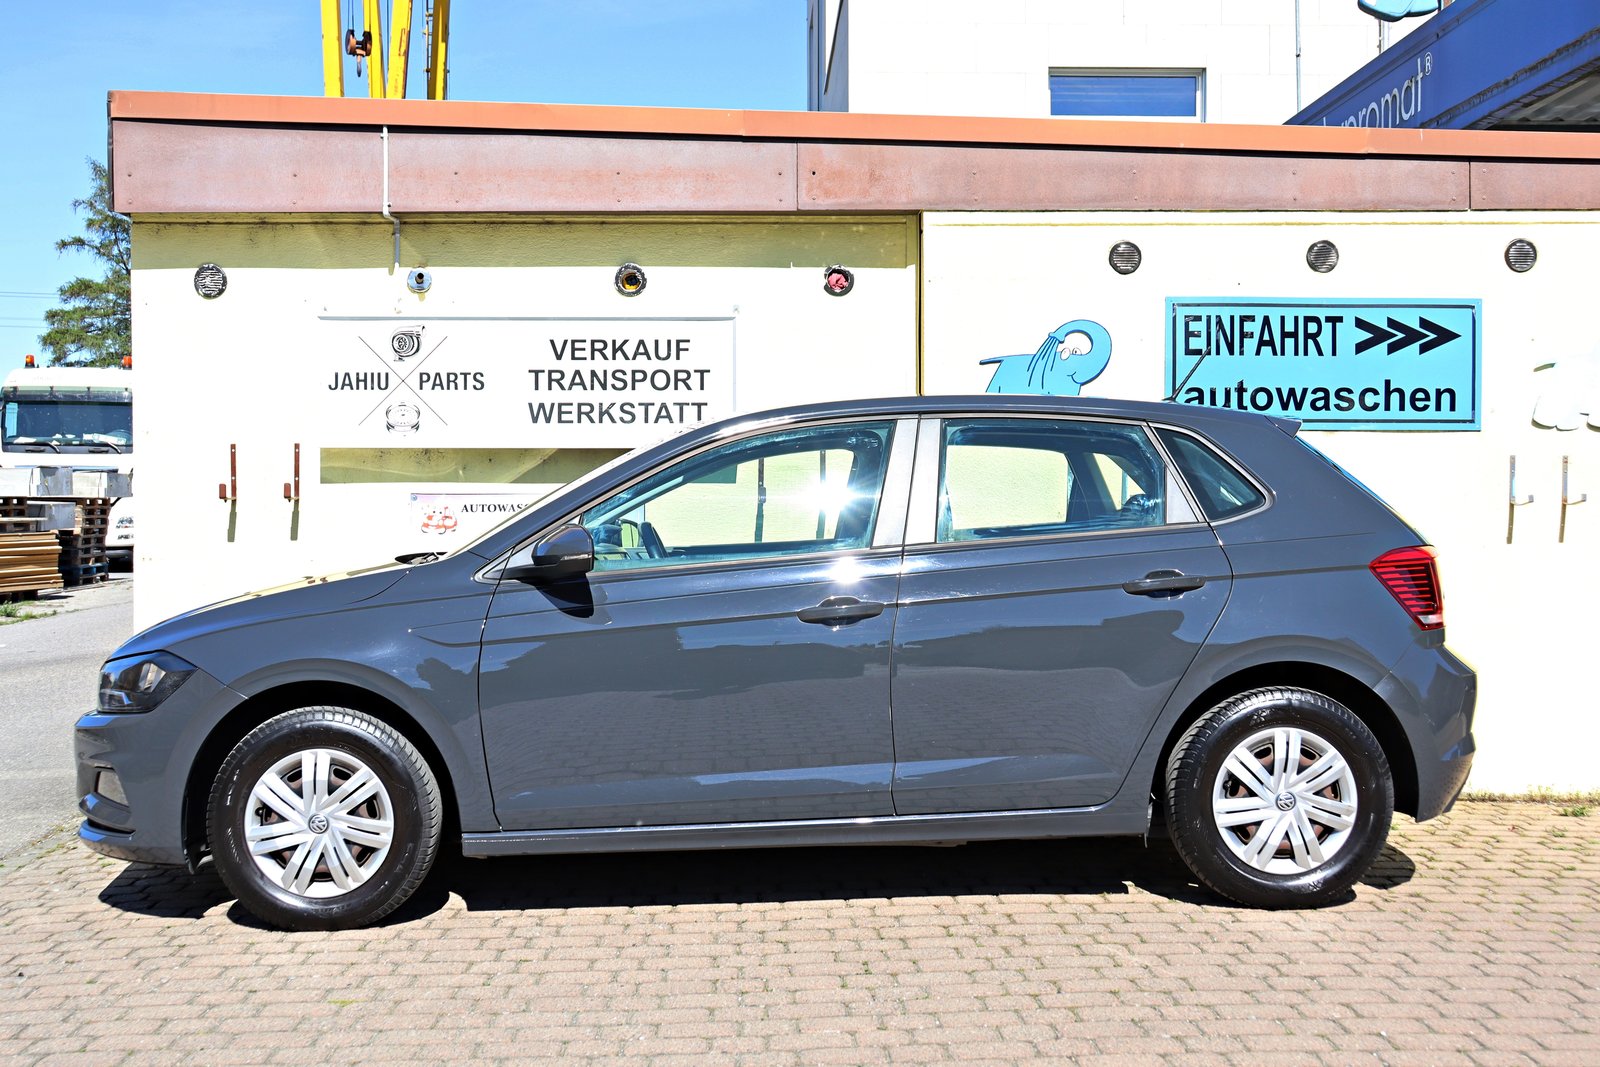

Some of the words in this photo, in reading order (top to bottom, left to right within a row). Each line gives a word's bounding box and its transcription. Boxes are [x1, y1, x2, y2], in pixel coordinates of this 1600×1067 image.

[1183, 314, 1344, 357] EINFAHRT
[549, 339, 691, 361] VERKAUF
[328, 372, 389, 391] JAHIU
[419, 372, 485, 391] PARTS
[528, 369, 711, 391] TRANSPORT
[1184, 379, 1456, 412] autowaschen
[528, 402, 708, 424] WERKSTATT
[461, 503, 528, 513] AUTOWAS
